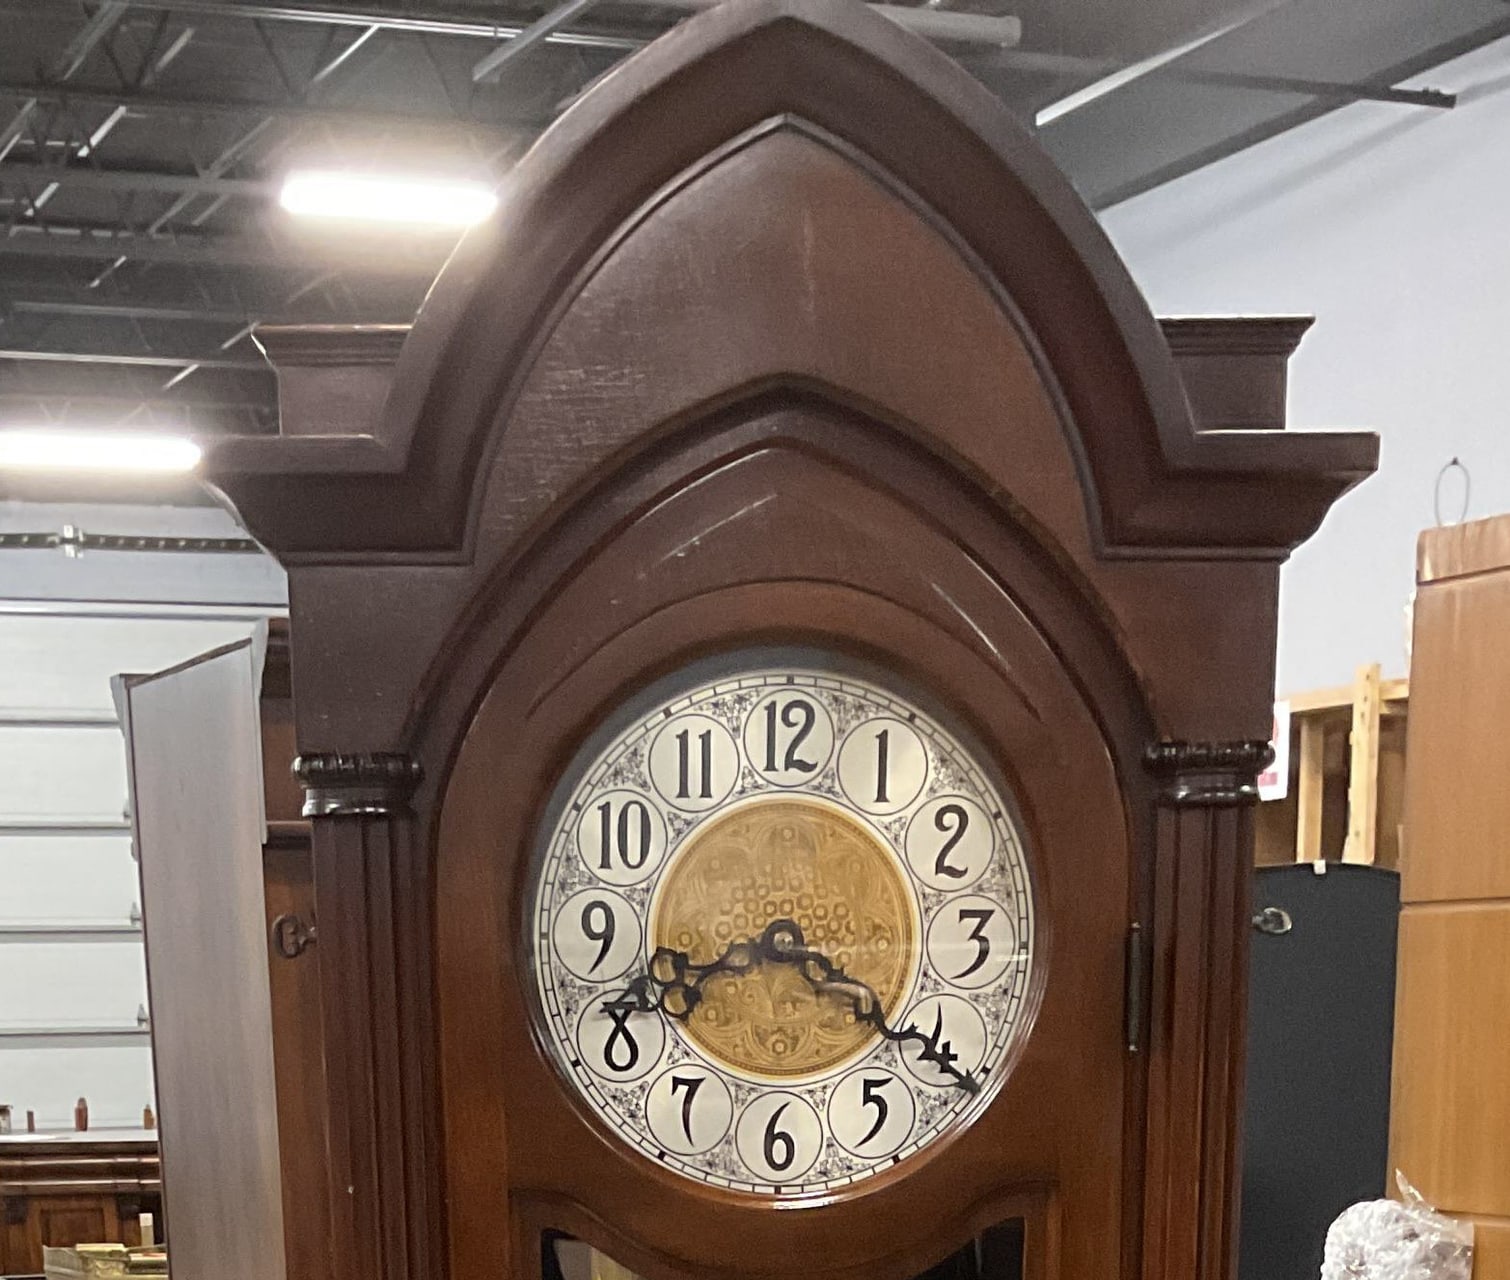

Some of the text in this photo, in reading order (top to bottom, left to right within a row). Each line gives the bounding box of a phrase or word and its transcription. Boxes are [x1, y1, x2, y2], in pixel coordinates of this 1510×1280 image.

[675, 729, 713, 799] 11
[763, 699, 819, 774] 12
[874, 729, 890, 803] 1
[597, 800, 652, 870] 10
[934, 804, 969, 879] 2
[581, 900, 617, 975] 9
[950, 909, 996, 980] 3
[602, 1001, 639, 1072] 8
[917, 1001, 958, 1074] 4
[671, 1075, 706, 1147] 7
[763, 1101, 795, 1172] 6
[854, 1076, 894, 1148] 5
